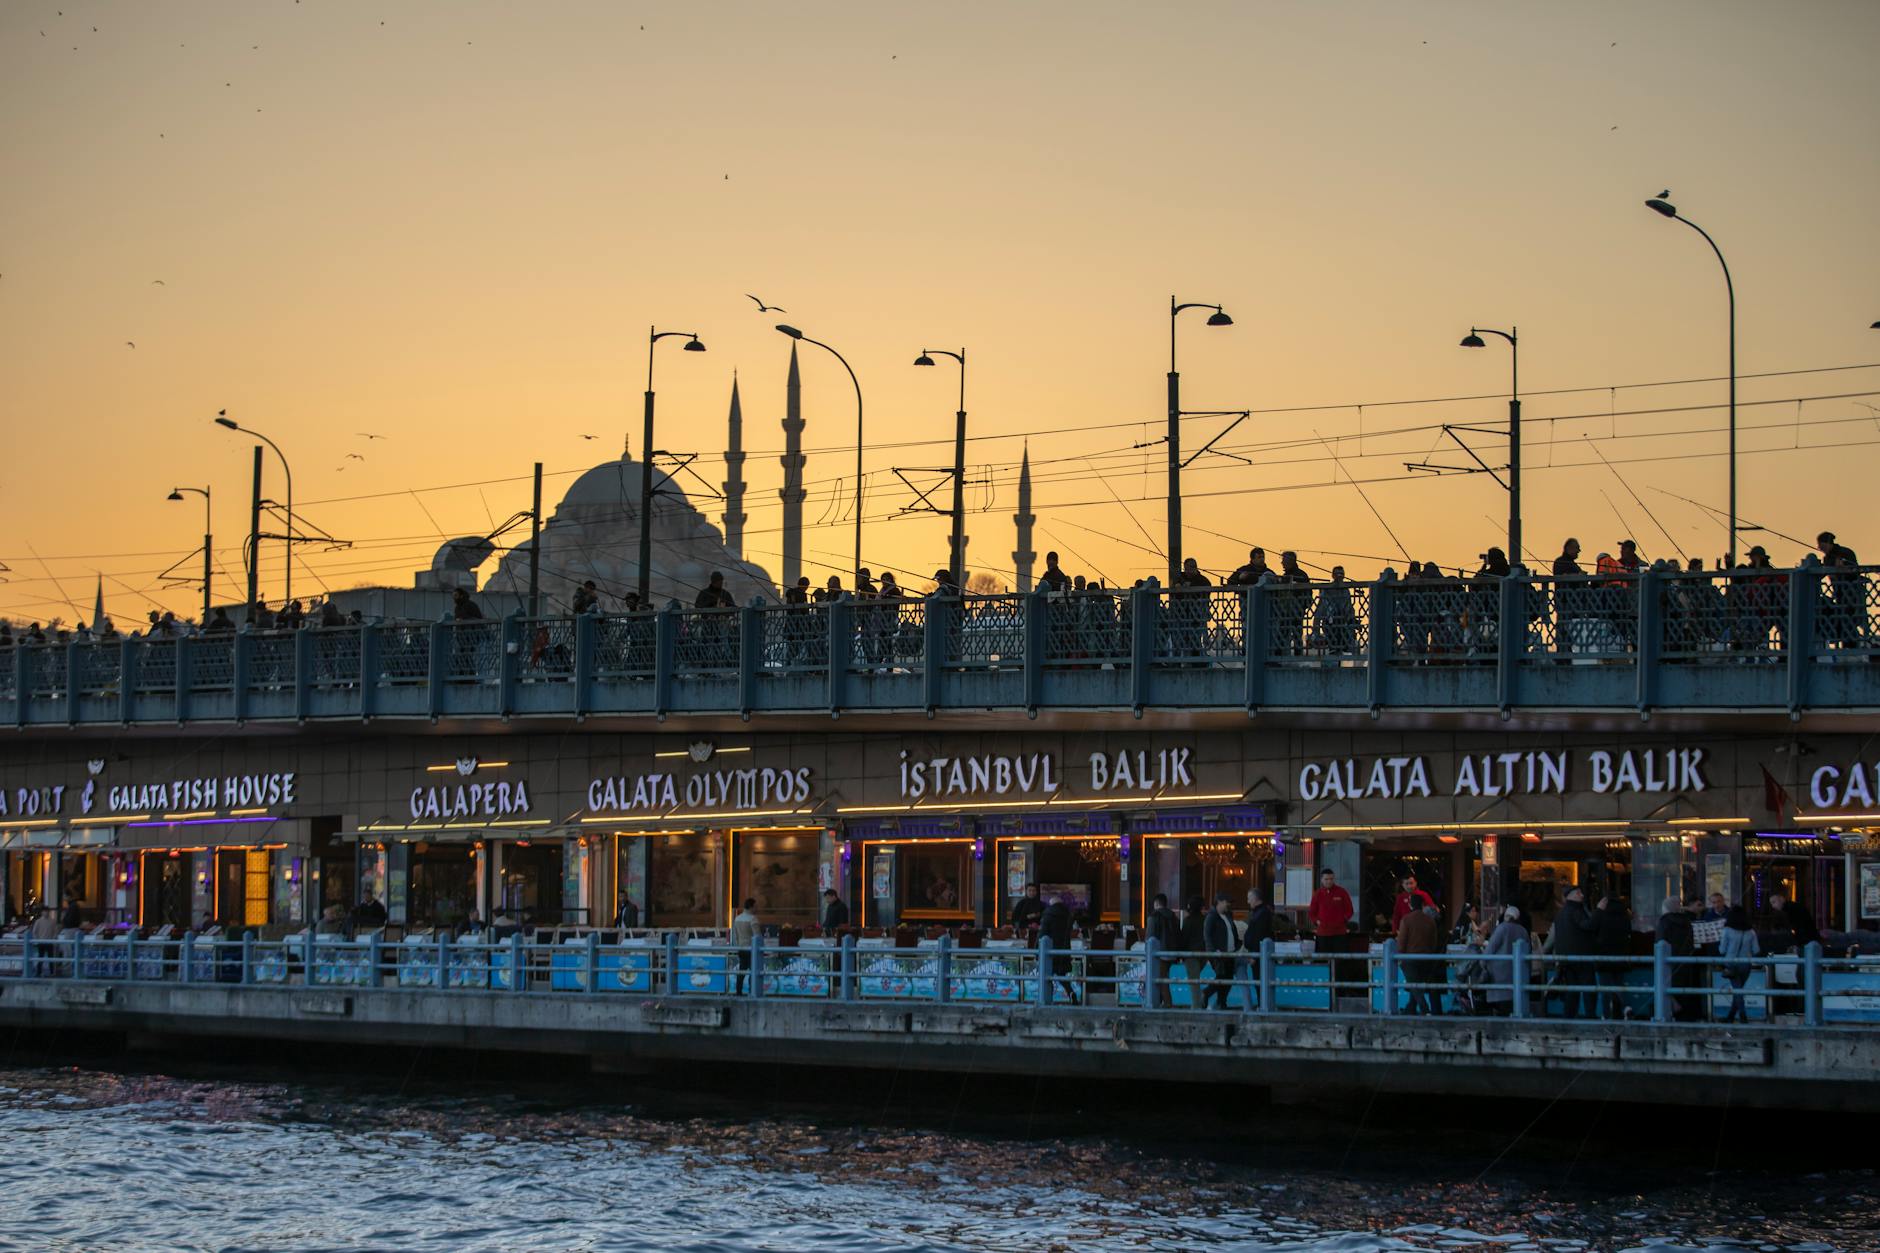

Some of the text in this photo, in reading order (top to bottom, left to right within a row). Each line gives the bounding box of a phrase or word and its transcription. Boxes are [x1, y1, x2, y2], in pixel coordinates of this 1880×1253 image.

[588, 766, 810, 812] GALATA OLYMPOS
[1090, 747, 1191, 790] BALIK
[1299, 748, 1705, 801] GALATA ALTIN BALIK
[1810, 761, 1880, 808] GA
[17, 785, 65, 816] PORT
[108, 783, 169, 812] GALATA
[172, 777, 218, 811] FISH
[410, 780, 530, 819] GALAPERA
